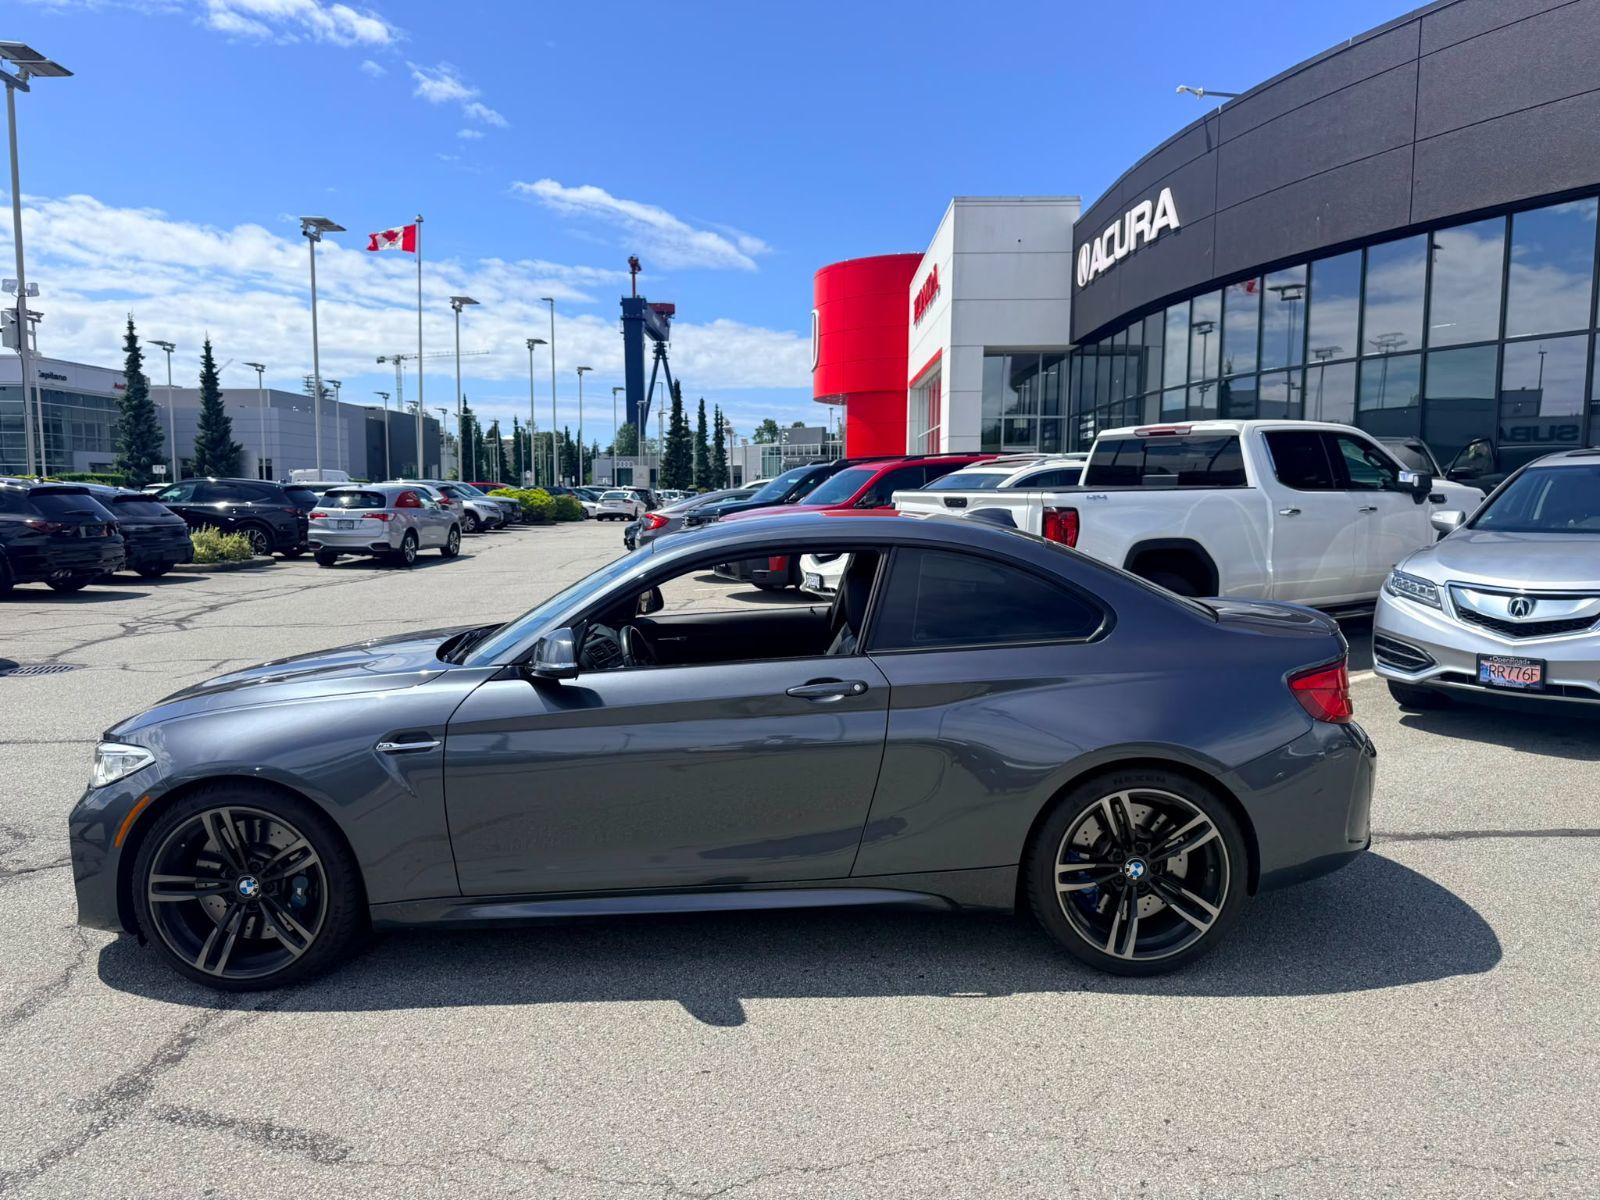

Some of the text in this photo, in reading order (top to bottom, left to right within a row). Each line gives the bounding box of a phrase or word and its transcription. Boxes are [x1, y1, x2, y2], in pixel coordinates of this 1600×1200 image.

[1088, 186, 1180, 281] ACURA
[38, 370, 67, 381] apilano
[1488, 664, 1540, 681] RR776F
